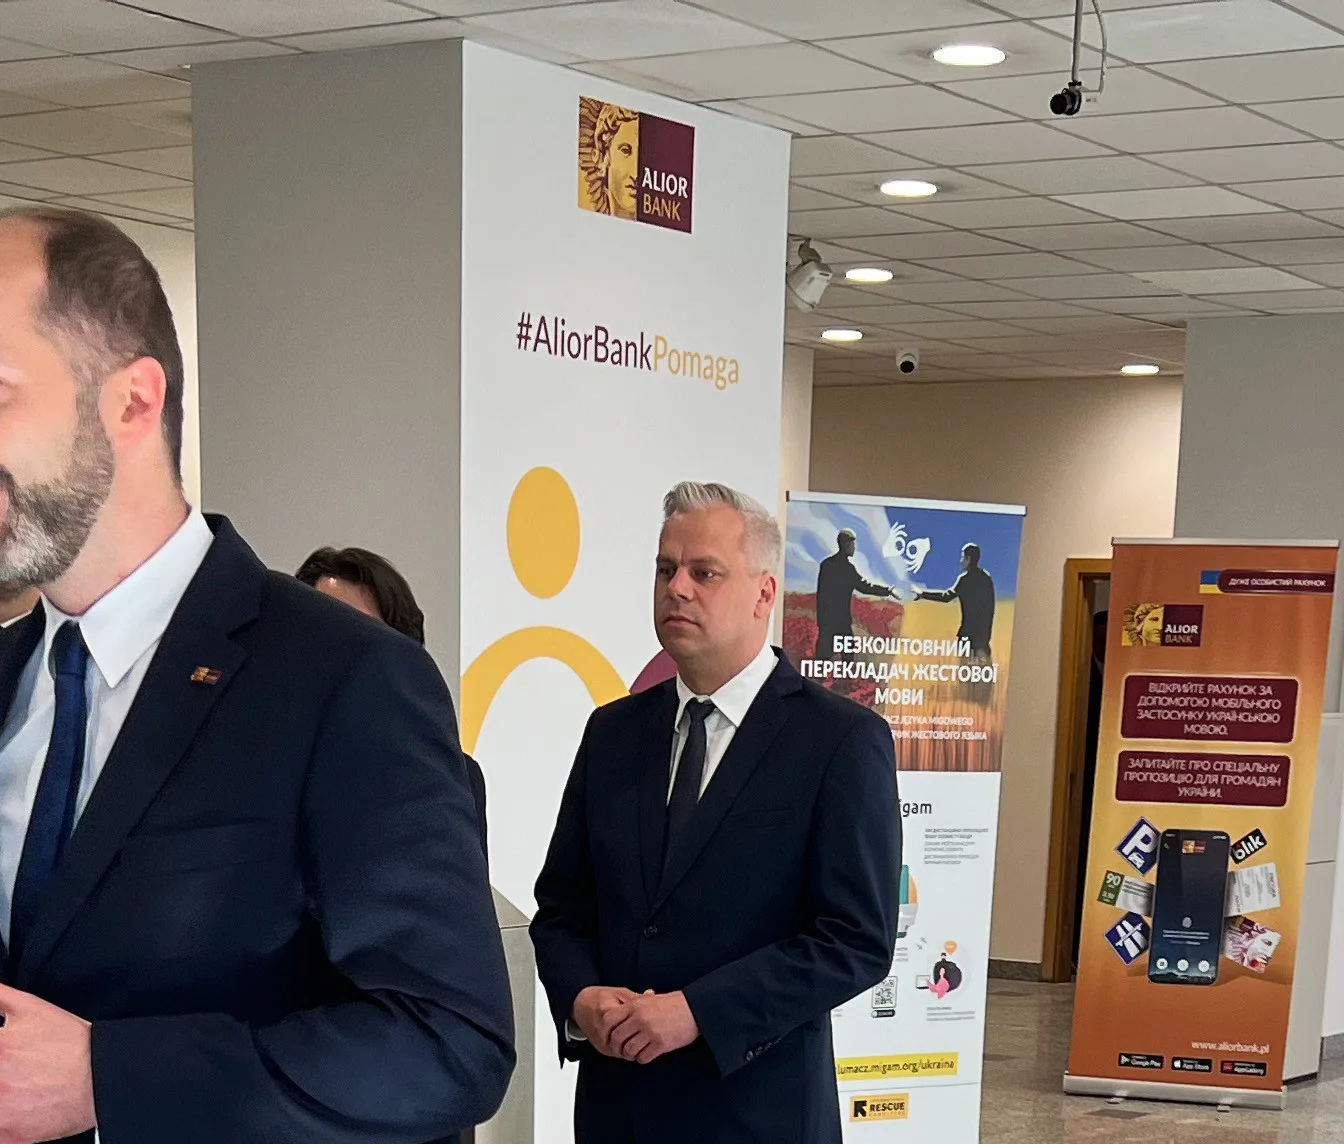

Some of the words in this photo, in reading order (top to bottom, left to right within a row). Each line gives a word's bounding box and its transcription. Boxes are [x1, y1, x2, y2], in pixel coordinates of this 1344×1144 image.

[641, 166, 689, 198] ALIOR
[643, 193, 681, 222] BANK
[516, 311, 740, 391] #AliorBankPomaga
[1164, 624, 1198, 634] ALIOR
[832, 635, 971, 658] БЕЗКОШТОВНИЙ
[1165, 634, 1193, 644] BANK
[800, 660, 909, 683] ПЕРЕКЛАДАЧ
[912, 662, 999, 684] ЖЕСТОВОЇ
[874, 687, 924, 706] МОВИ
[1148, 681, 1205, 694] ВІДКРИЙТЕ
[1207, 683, 1257, 695] РАХУНОК
[1257, 685, 1273, 696] ЗА
[1137, 696, 1210, 708] ДОПОМОГОЮ
[1211, 697, 1282, 710] МОБІЛЬНОГО
[1136, 709, 1204, 721] ЗАСТОСУНКУ
[1205, 710, 1281, 723] УКРАЇНСЬКОЮ
[1128, 757, 1186, 770] ЗАПИТАЙТЕ
[1188, 760, 1211, 772] ПРО
[1212, 761, 1281, 774] СПЕЦІАЛЬНУ
[1123, 771, 1194, 784] ПРОПОЗИЦІЮ
[1194, 773, 1218, 785] ДЛЯ
[1220, 774, 1281, 787] ГРОМАДЯН
[1106, 873, 1121, 886] 90
[837, 1058, 954, 1075] lumacz.migam.org/ukraina
[869, 1102, 905, 1112] RESCUE
